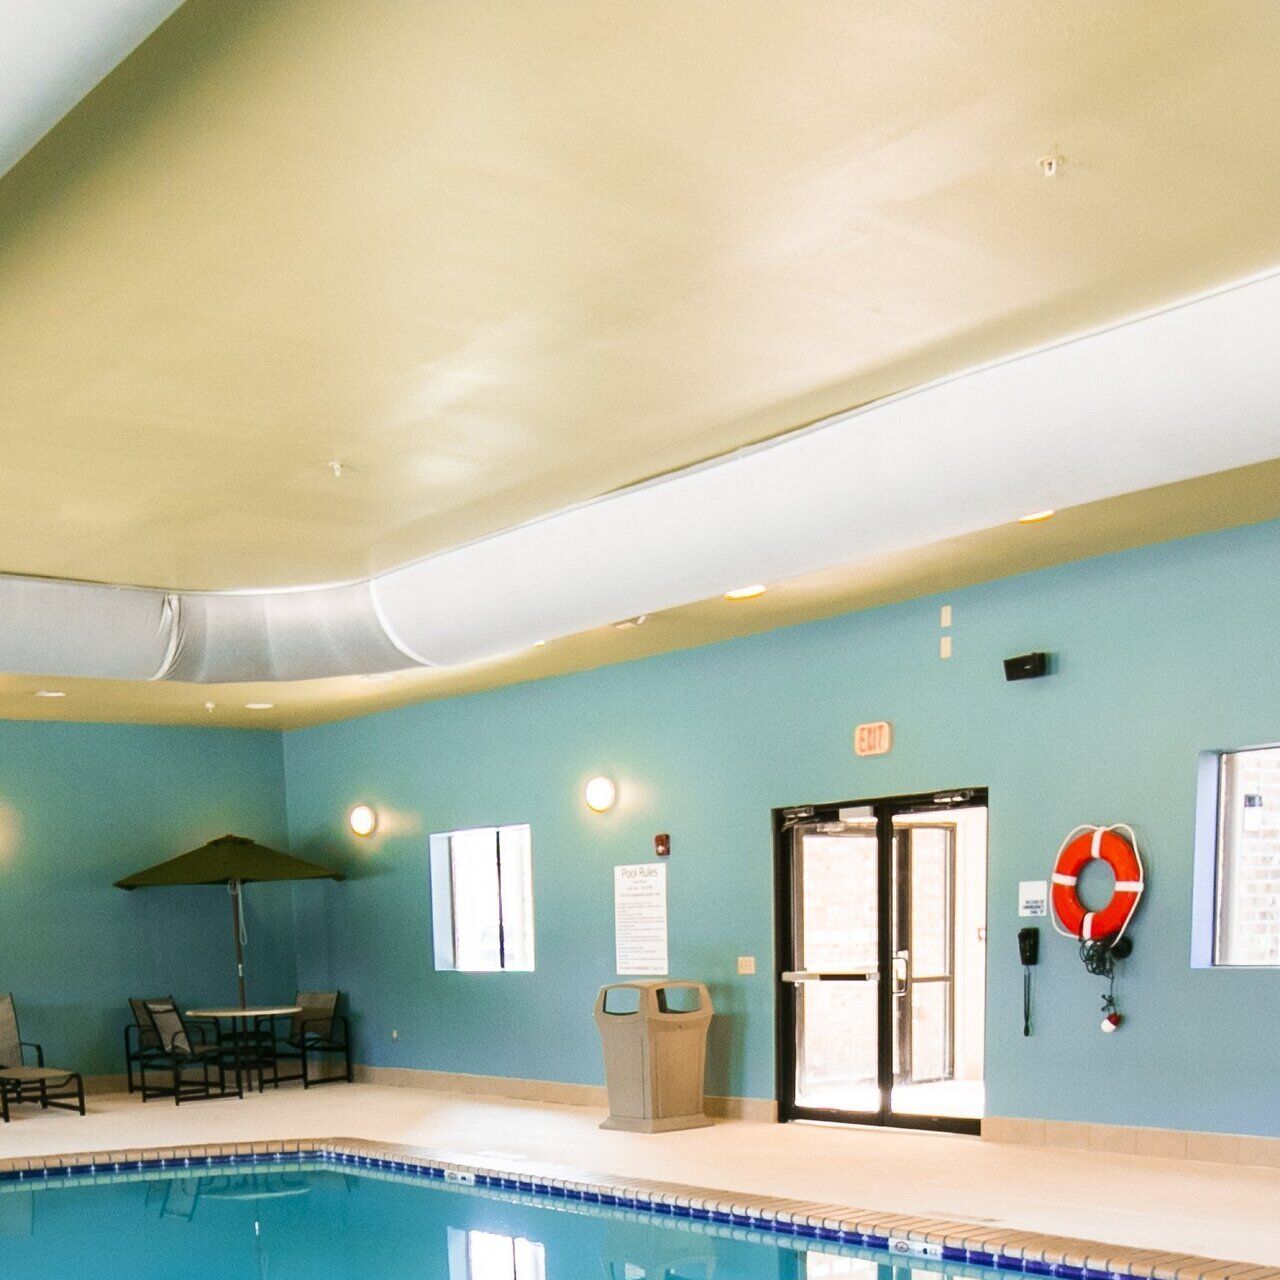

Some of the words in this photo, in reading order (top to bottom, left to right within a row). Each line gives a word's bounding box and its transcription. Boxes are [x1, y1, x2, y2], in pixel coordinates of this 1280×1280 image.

[859, 725, 884, 752] EXIT
[621, 868, 637, 879] Pool
[639, 866, 658, 878] Rules
